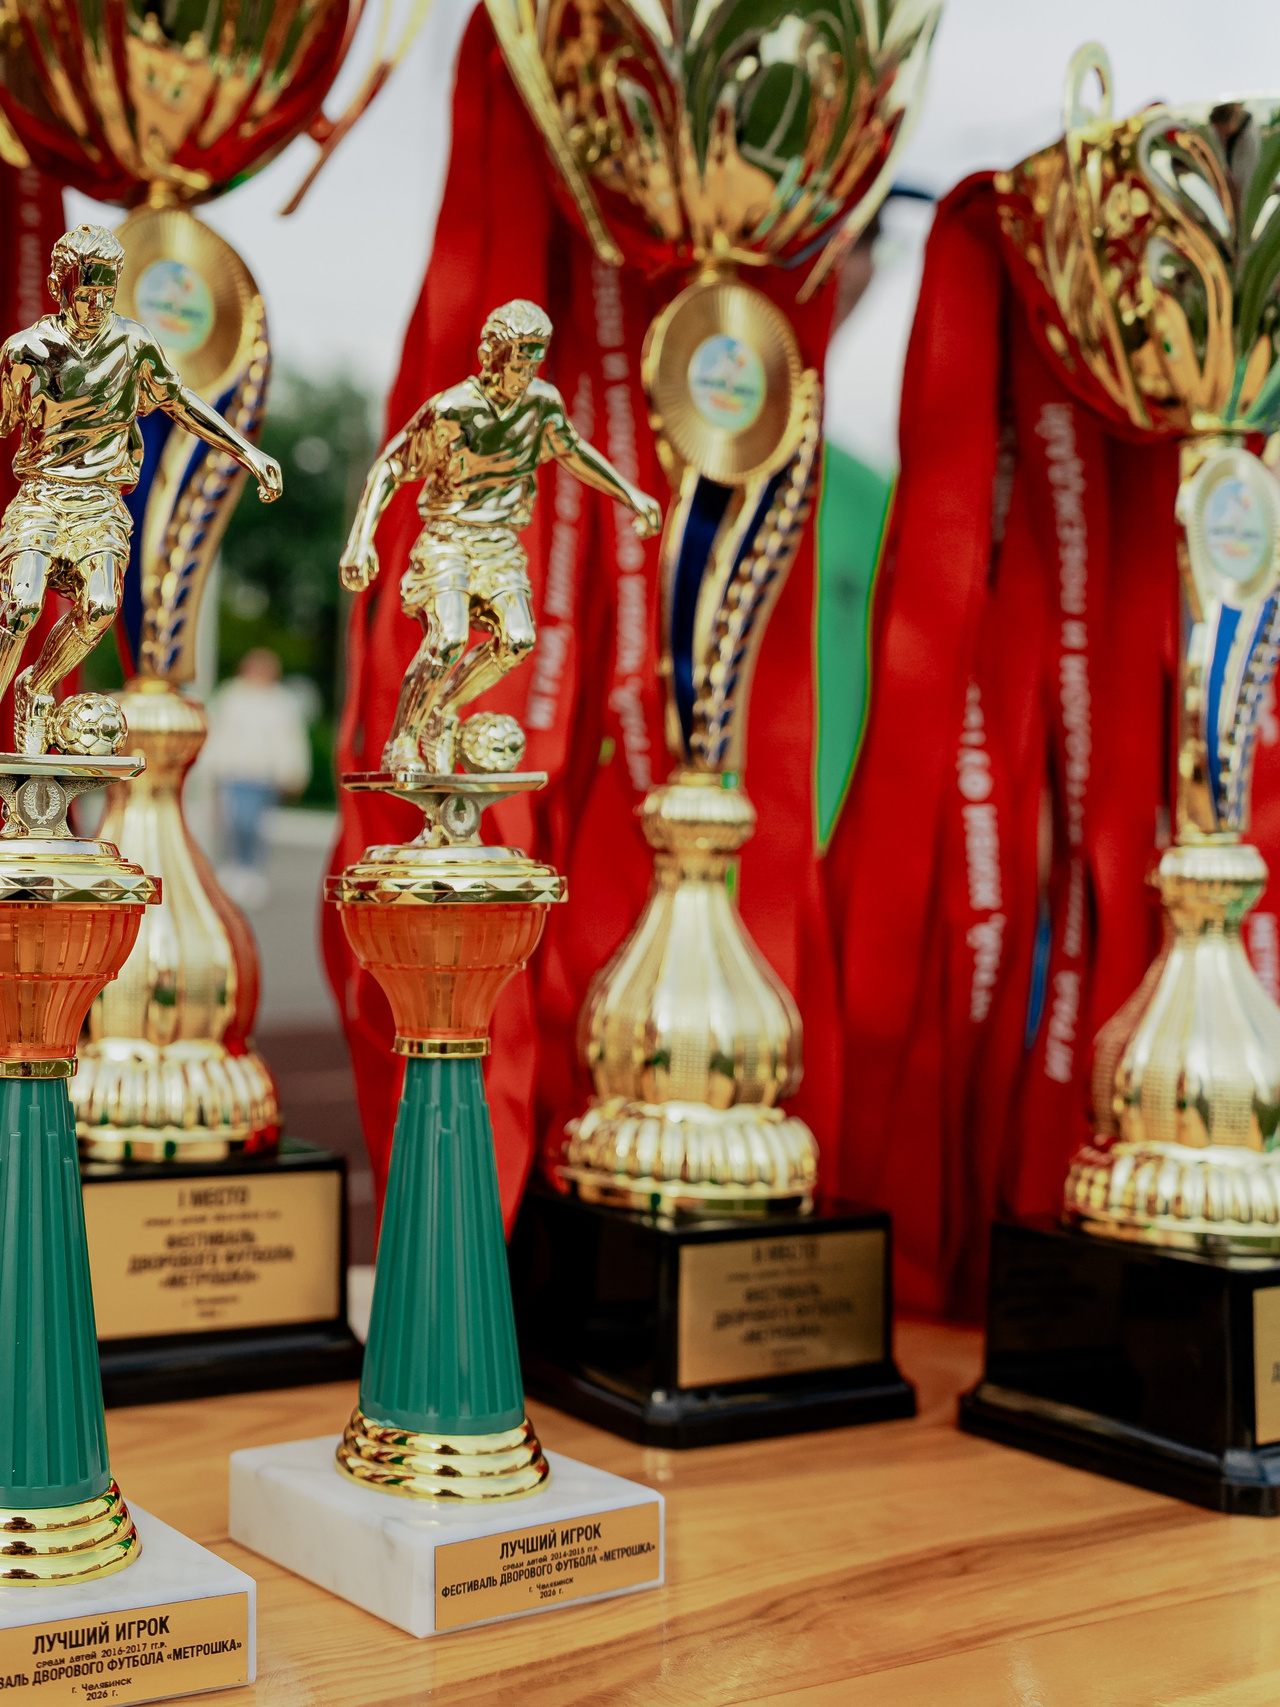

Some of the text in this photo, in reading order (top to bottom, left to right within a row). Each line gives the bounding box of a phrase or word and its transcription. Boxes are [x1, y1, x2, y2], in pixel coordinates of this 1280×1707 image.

[500, 1523, 602, 1560] ЛУЧШИЙ ИГРОК
[441, 1542, 655, 1598] ФЕСТИВАЛЬ ДВОРОВОГО ФУТБОЛА «МЕТРОШКА»
[540, 1588, 556, 1599] 2026
[32, 1615, 170, 1655] ЛУЧШИЙ ИГРОК
[32, 1660, 104, 1686] ДВОРОВОГО
[107, 1651, 164, 1672] ФУТБОЛА
[167, 1639, 242, 1661] «МЕТРОШКА»
[101, 1643, 147, 1658] 2016-2017
[82, 1678, 132, 1692] Челябинск
[86, 1690, 108, 1701] 2026
